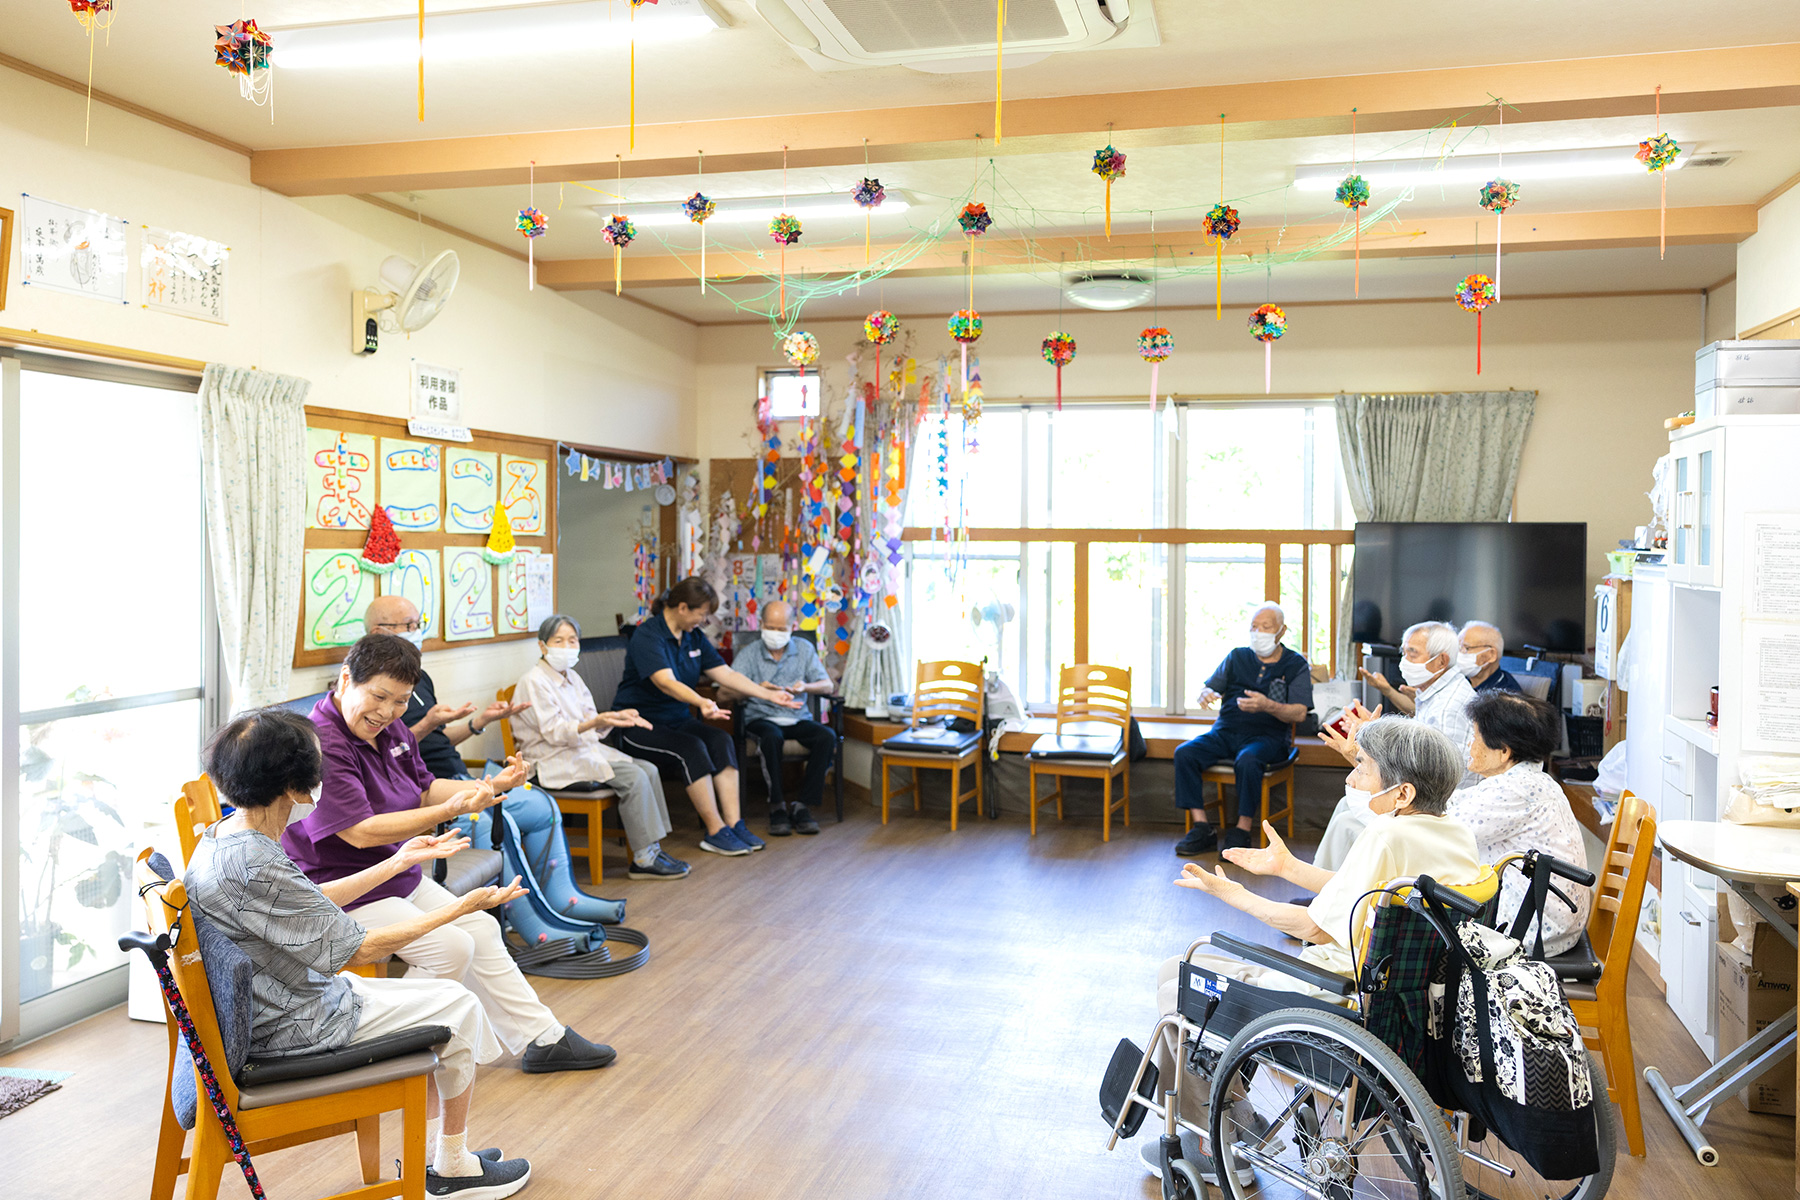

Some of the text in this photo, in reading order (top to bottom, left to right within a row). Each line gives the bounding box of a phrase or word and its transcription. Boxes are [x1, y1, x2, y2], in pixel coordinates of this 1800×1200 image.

[420, 375, 456, 394] 利用者様
[428, 395, 448, 411] 作品
[733, 560, 743, 575] 8
[1601, 594, 1610, 633] 6
[1758, 979, 1791, 992] Amway
